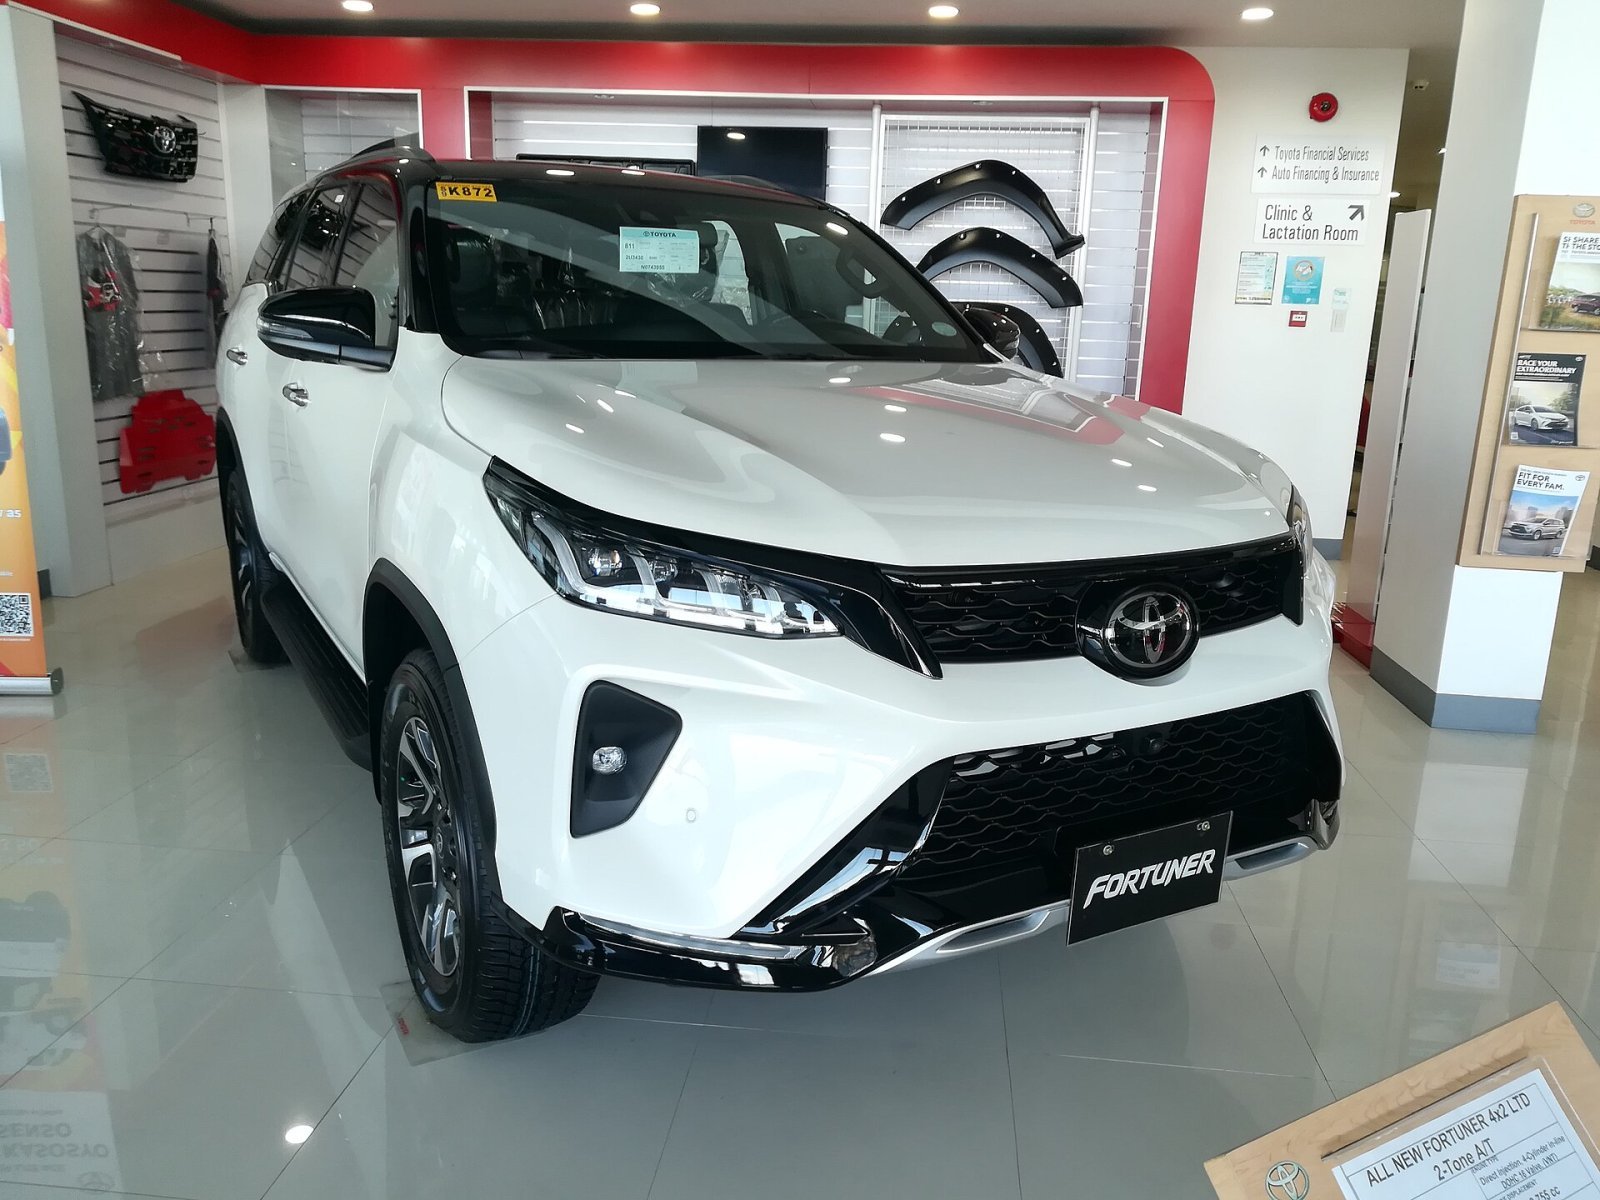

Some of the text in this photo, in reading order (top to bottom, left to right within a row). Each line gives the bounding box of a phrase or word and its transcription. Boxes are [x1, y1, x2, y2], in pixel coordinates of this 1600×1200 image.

[1275, 146, 1370, 163] Toyota Financial Services
[1272, 165, 1380, 184] Auto Financing & Insurance
[448, 186, 494, 198] K872
[1265, 204, 1313, 221] Clinic &
[1262, 223, 1359, 241] Lactation Room
[1516, 366, 1577, 374] EXTRAORDINARY
[1517, 359, 1537, 367] RACE
[1516, 478, 1544, 489] EVERY
[1545, 482, 1565, 491] FAM.
[1519, 471, 1532, 479] FIT
[1532, 474, 1550, 482] FOR
[1083, 849, 1216, 910] FORTUNER
[1366, 1092, 1531, 1187] ALL NEW FORTUNER 4x2 LTD
[1433, 1138, 1496, 1181] 2-Tone A/T
[1480, 1171, 1499, 1186] Direct
[1521, 1143, 1550, 1162] 4-Cylinder
[1500, 1173, 1520, 1189] DOHC
[1518, 1169, 1527, 1179] 16
[1542, 1152, 1560, 1168] (VNT)
[1550, 1186, 1561, 1198] cc
